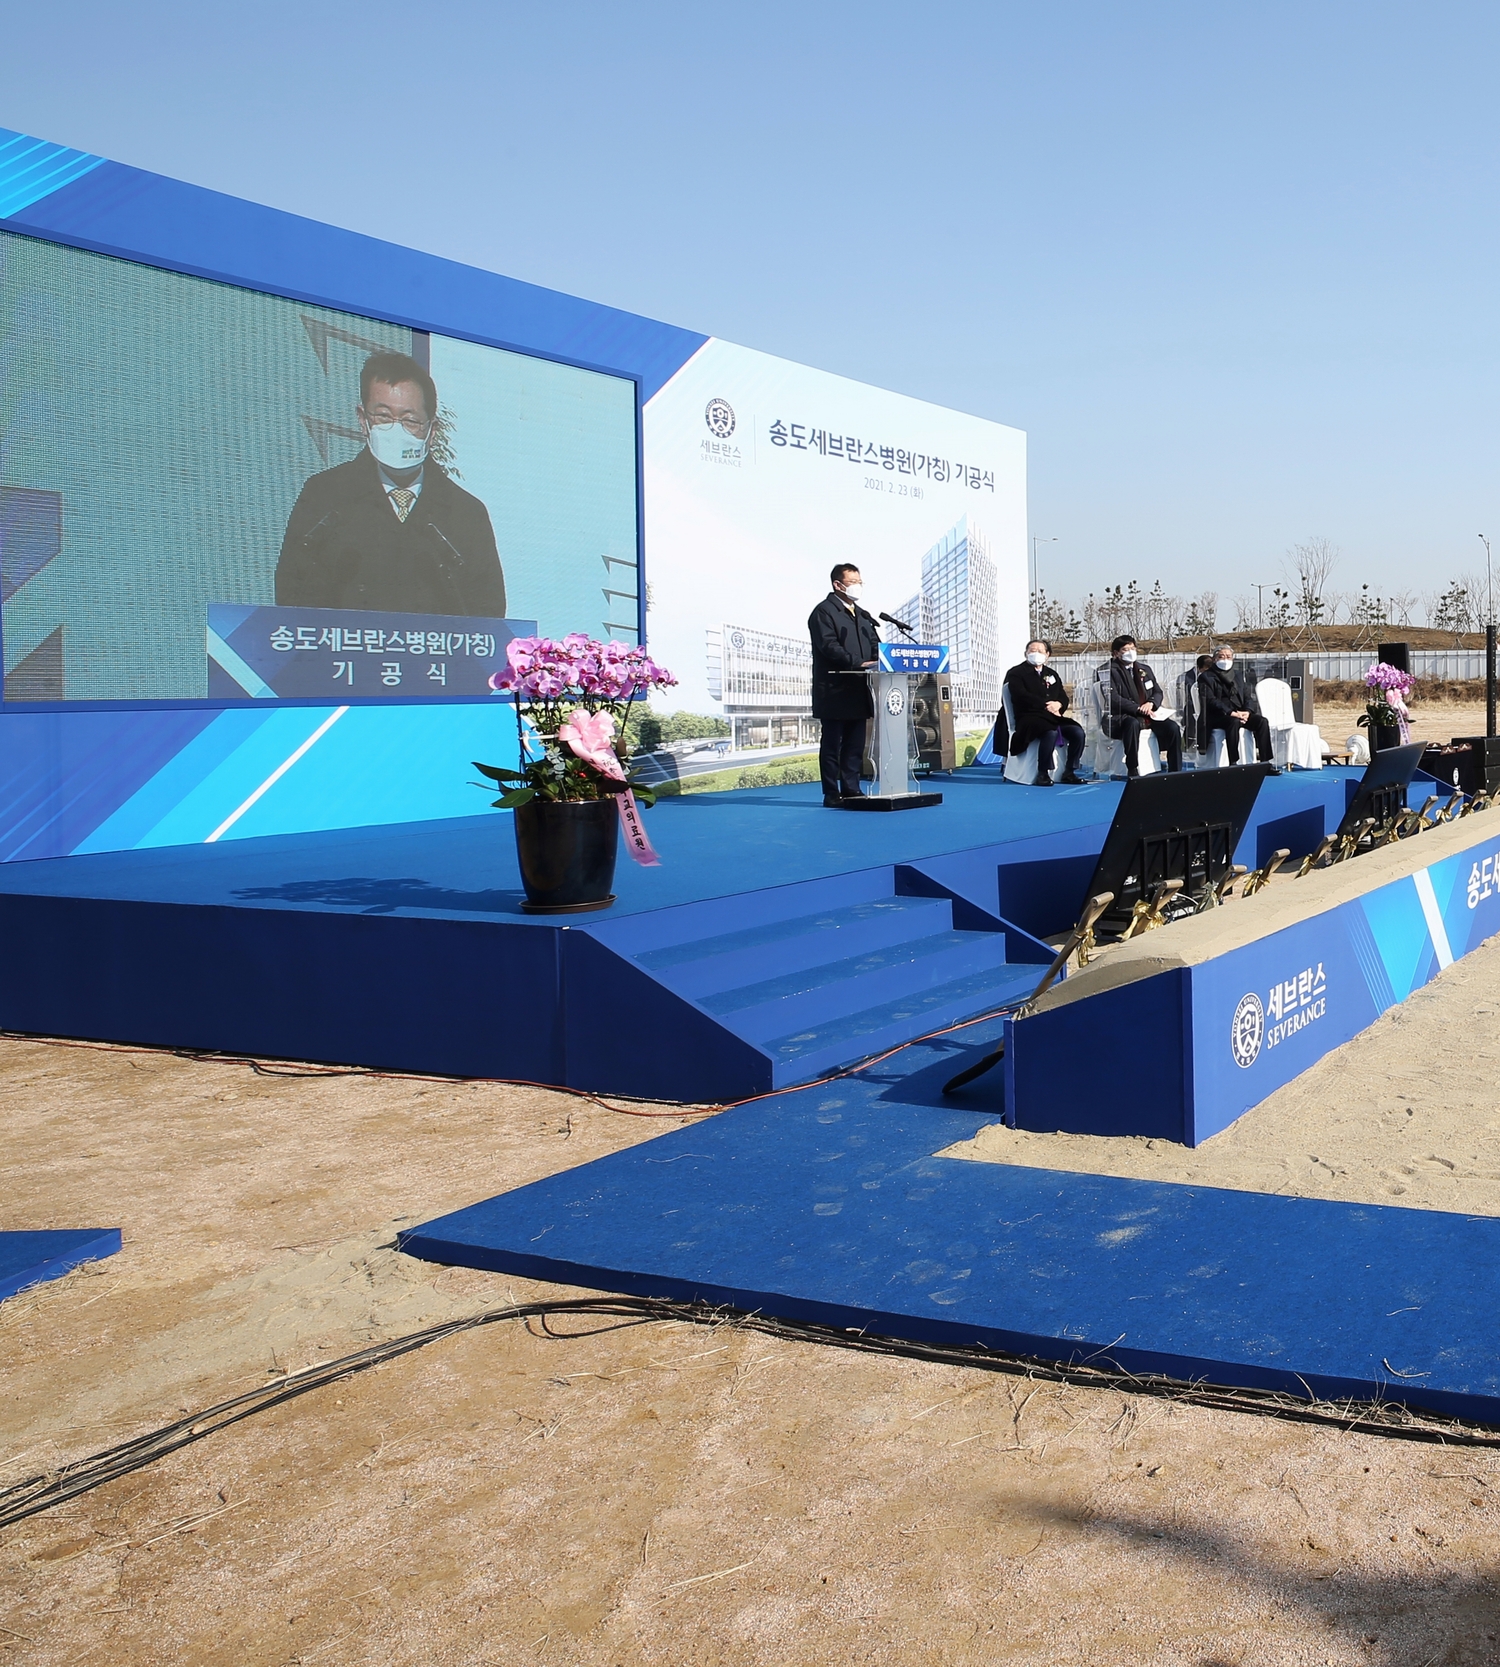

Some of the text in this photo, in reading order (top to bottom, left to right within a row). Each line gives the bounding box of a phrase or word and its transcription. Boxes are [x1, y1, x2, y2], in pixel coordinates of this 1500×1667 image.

[700, 440, 742, 459] 세브란스
[700, 453, 742, 468] SEVERANCE
[769, 418, 951, 483] 송도세브란스병원(가칭)
[955, 463, 995, 493] 기공식
[864, 477, 886, 492] 2021.
[897, 484, 908, 497] 23
[910, 486, 925, 501] (화)
[269, 625, 496, 658] 송도세브란스병원(가칭)
[1266, 962, 1327, 1021] 세브란스
[1267, 997, 1327, 1050] SEVERANCE
